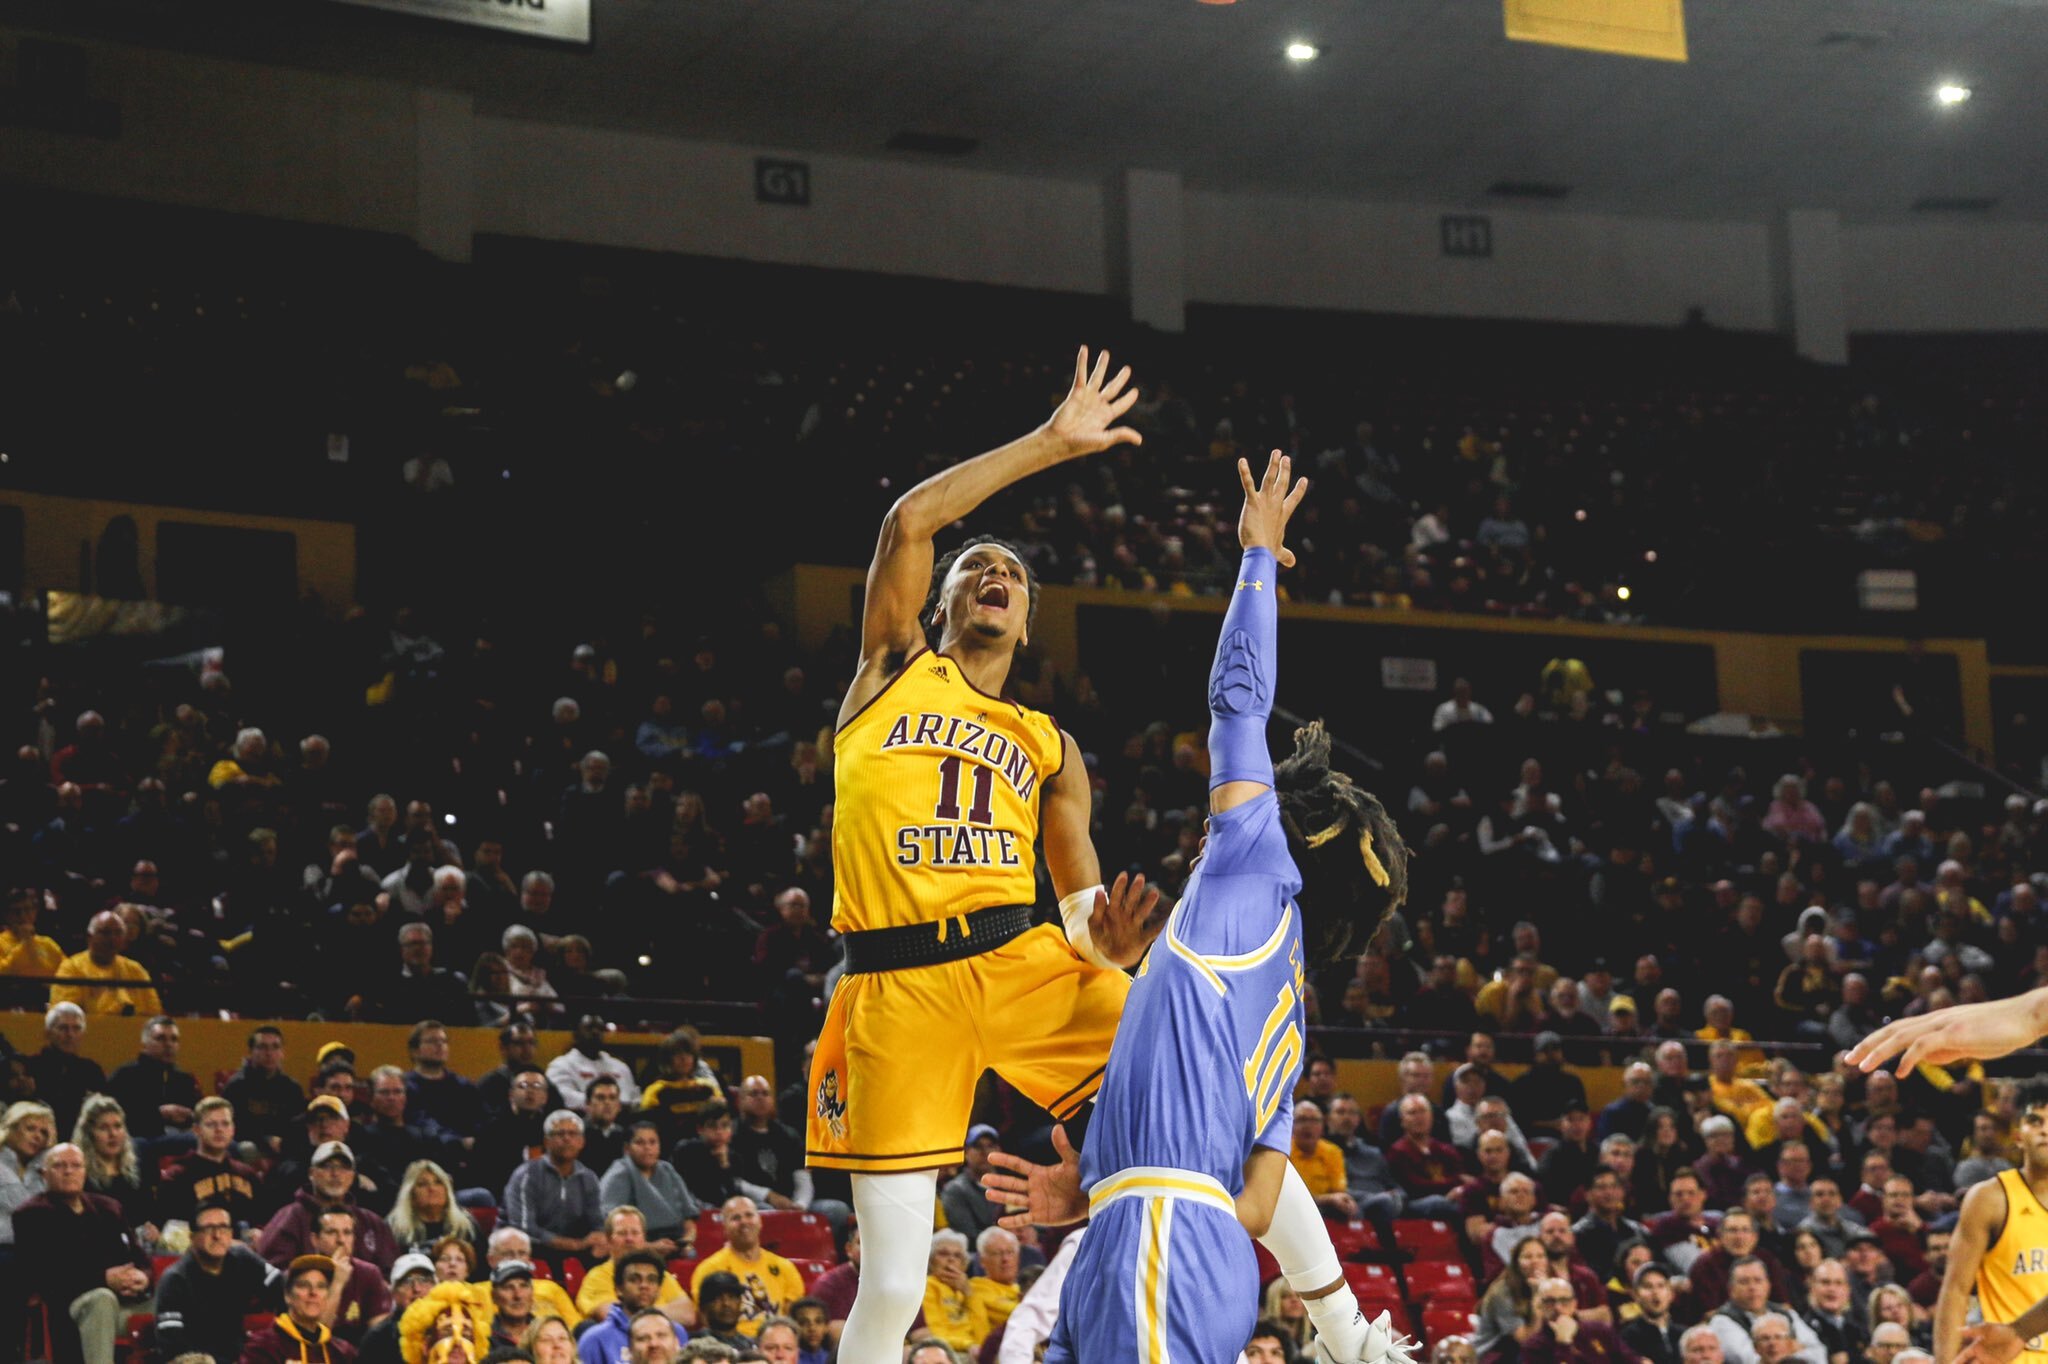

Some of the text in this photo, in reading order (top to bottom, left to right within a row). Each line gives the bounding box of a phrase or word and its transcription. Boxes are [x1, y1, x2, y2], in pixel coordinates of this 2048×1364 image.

[763, 168, 804, 196] G1
[882, 713, 1038, 803] ARIZONA
[934, 755, 994, 826] 11
[897, 824, 1019, 867] STATE
[1243, 980, 1303, 1139] 10
